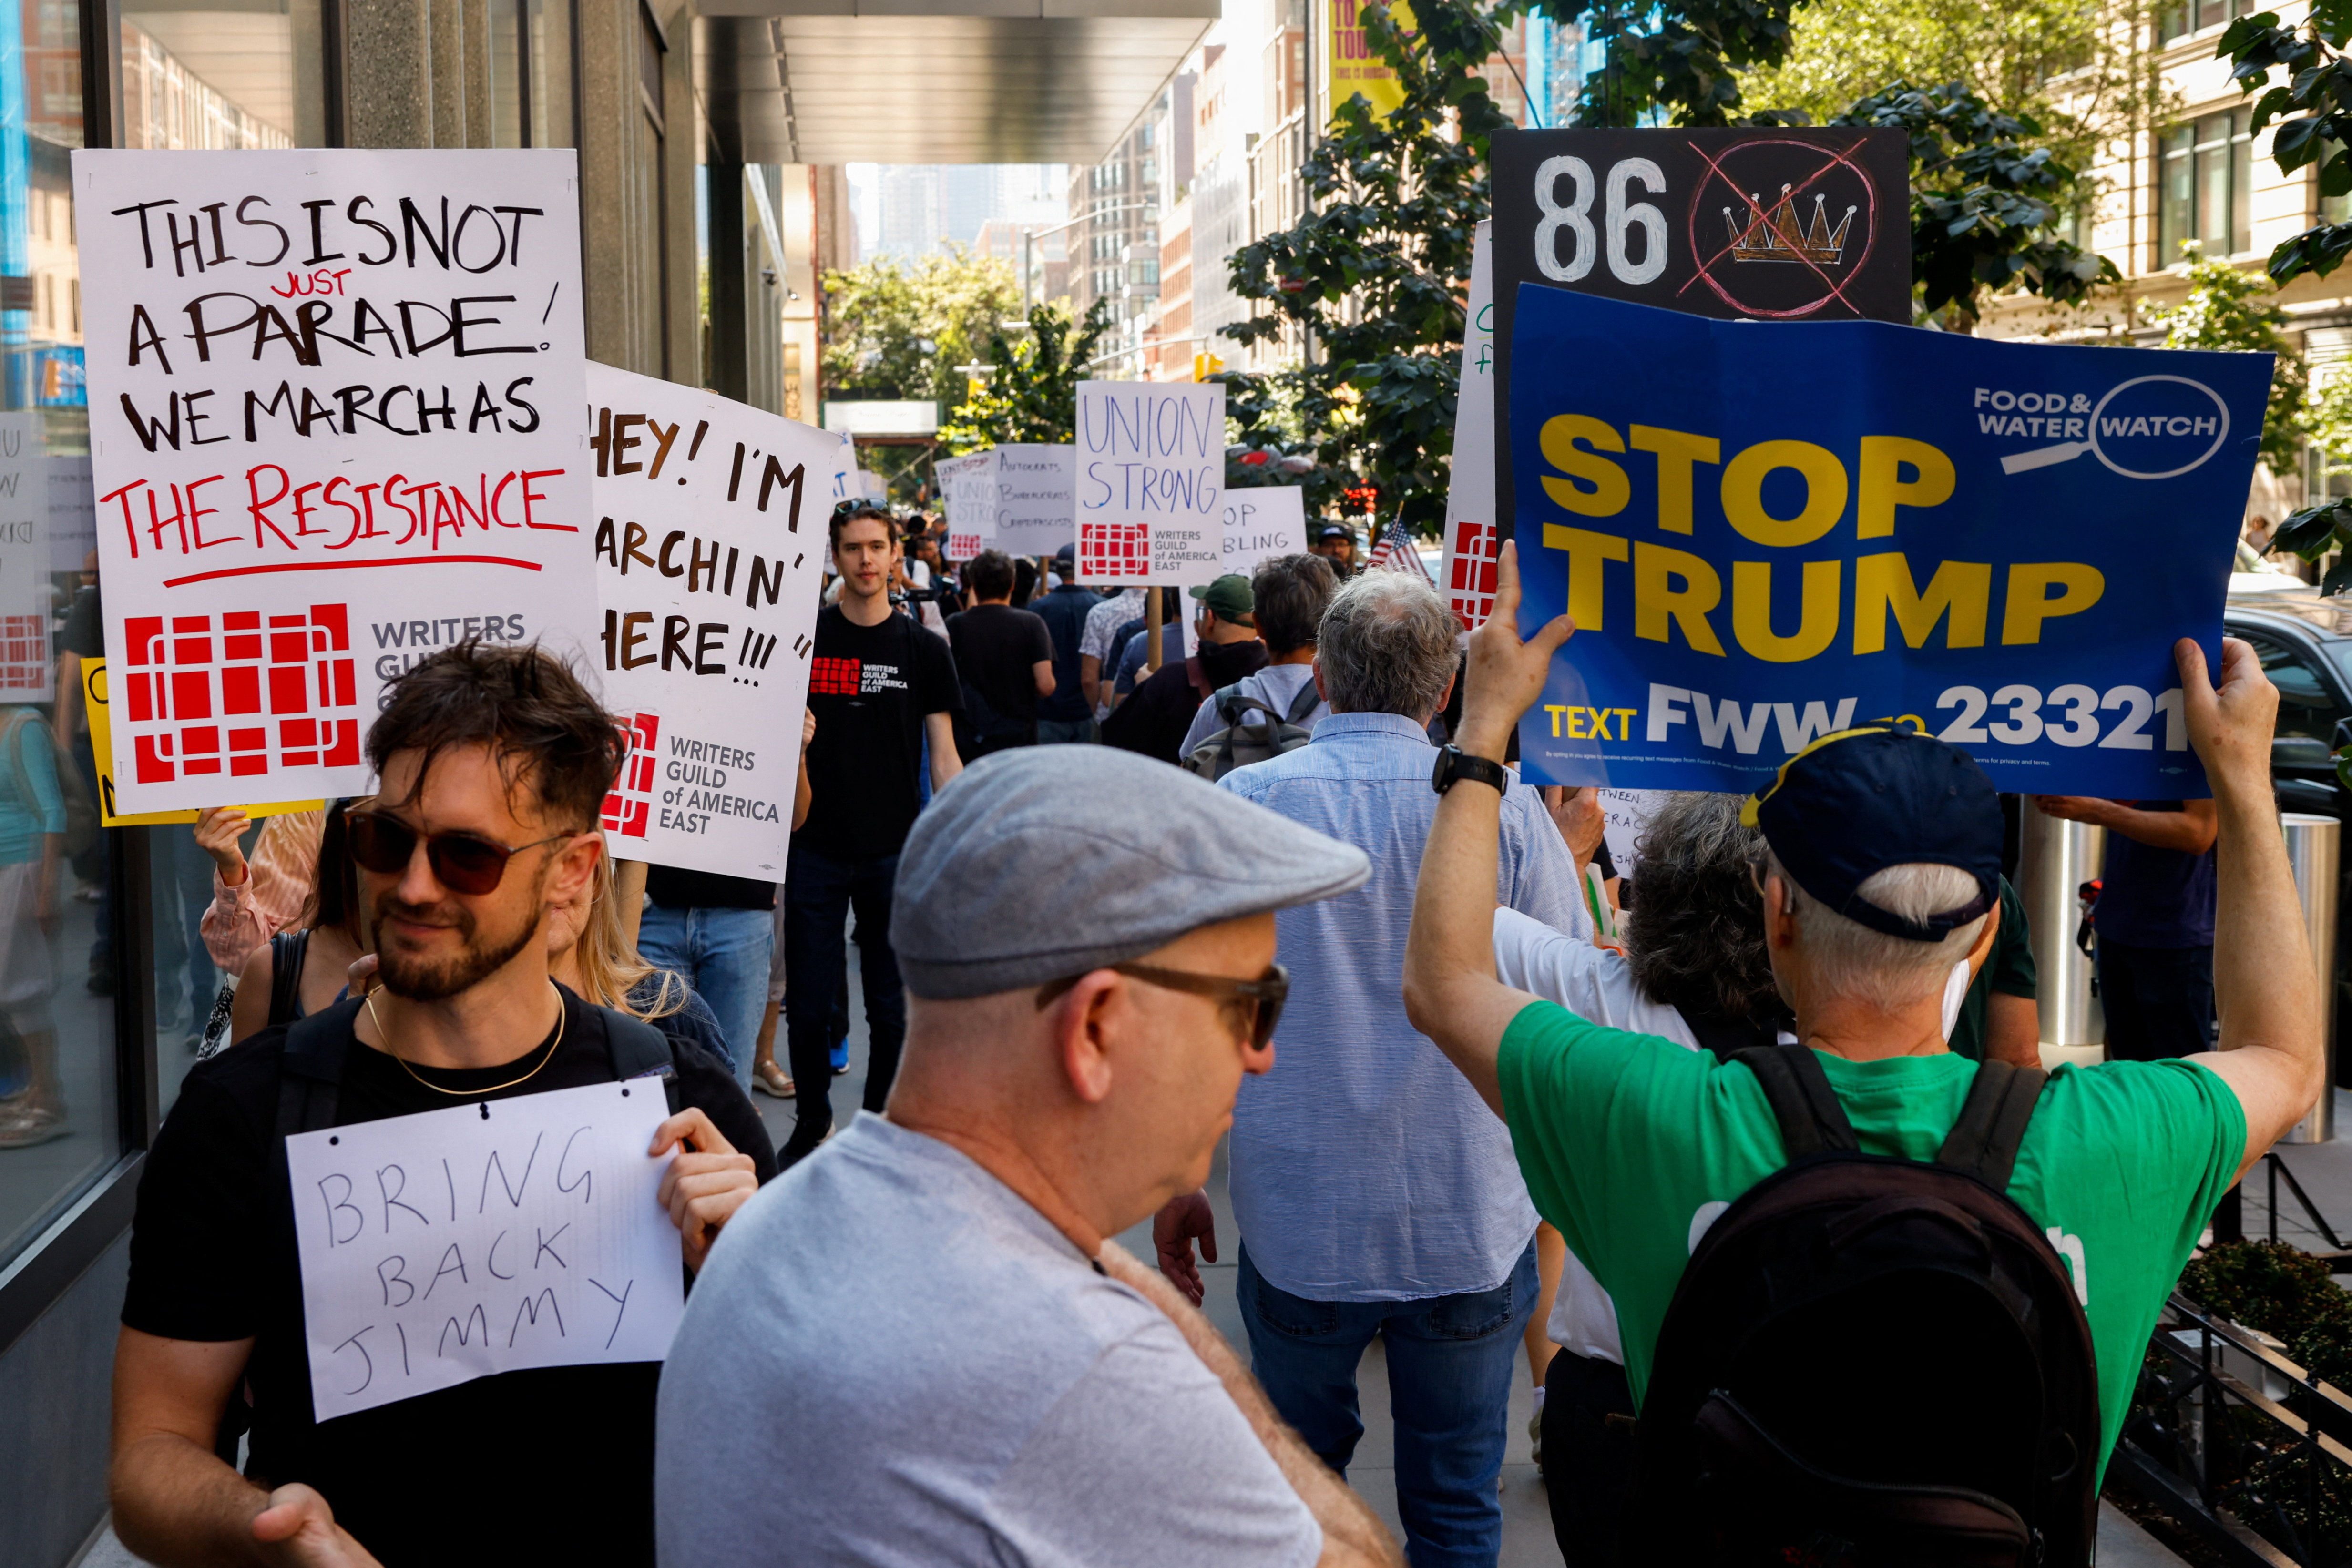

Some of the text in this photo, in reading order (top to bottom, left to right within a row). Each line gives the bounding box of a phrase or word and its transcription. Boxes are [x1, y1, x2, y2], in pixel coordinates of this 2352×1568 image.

[111, 196, 543, 277] THIS IS NOT
[1534, 155, 1668, 285] 86
[270, 268, 352, 298] JUST
[128, 281, 559, 375] A PARADE!
[120, 377, 540, 452] WE MARCH AS
[1084, 395, 1213, 458] UNION
[1978, 413, 2216, 438] WATER WATCH
[727, 441, 805, 534] I'M
[956, 481, 995, 500] UNIO
[1083, 461, 1216, 514] STRONG
[1540, 413, 1956, 548] STOP
[100, 464, 579, 558] THE RESISTANCE
[1223, 504, 1256, 526] OP
[1155, 530, 1201, 540] WRITERS
[1155, 541, 1187, 550] GUILD
[1223, 532, 1288, 553] BLING
[596, 516, 804, 610] ARCHIN'
[1154, 562, 1182, 571] EAST
[1155, 551, 1217, 561] of AMERICA
[1542, 521, 2105, 662] TRUMP
[371, 614, 525, 649] WRITERS
[863, 664, 898, 674] WRITERS
[872, 680, 908, 689] AMERICA
[1544, 704, 1637, 741] TEXT
[1646, 682, 1858, 755] FWW
[1936, 683, 2188, 752] 23321
[670, 736, 756, 771] WRITERS
[666, 761, 726, 789] GUILD
[663, 788, 779, 824] of AMERICA
[1597, 788, 1640, 804] TWEEN
[659, 808, 711, 835] EAST
[318, 1126, 592, 1248] BRING
[377, 1223, 571, 1308] BACK
[332, 1279, 633, 1395] JIMMY
